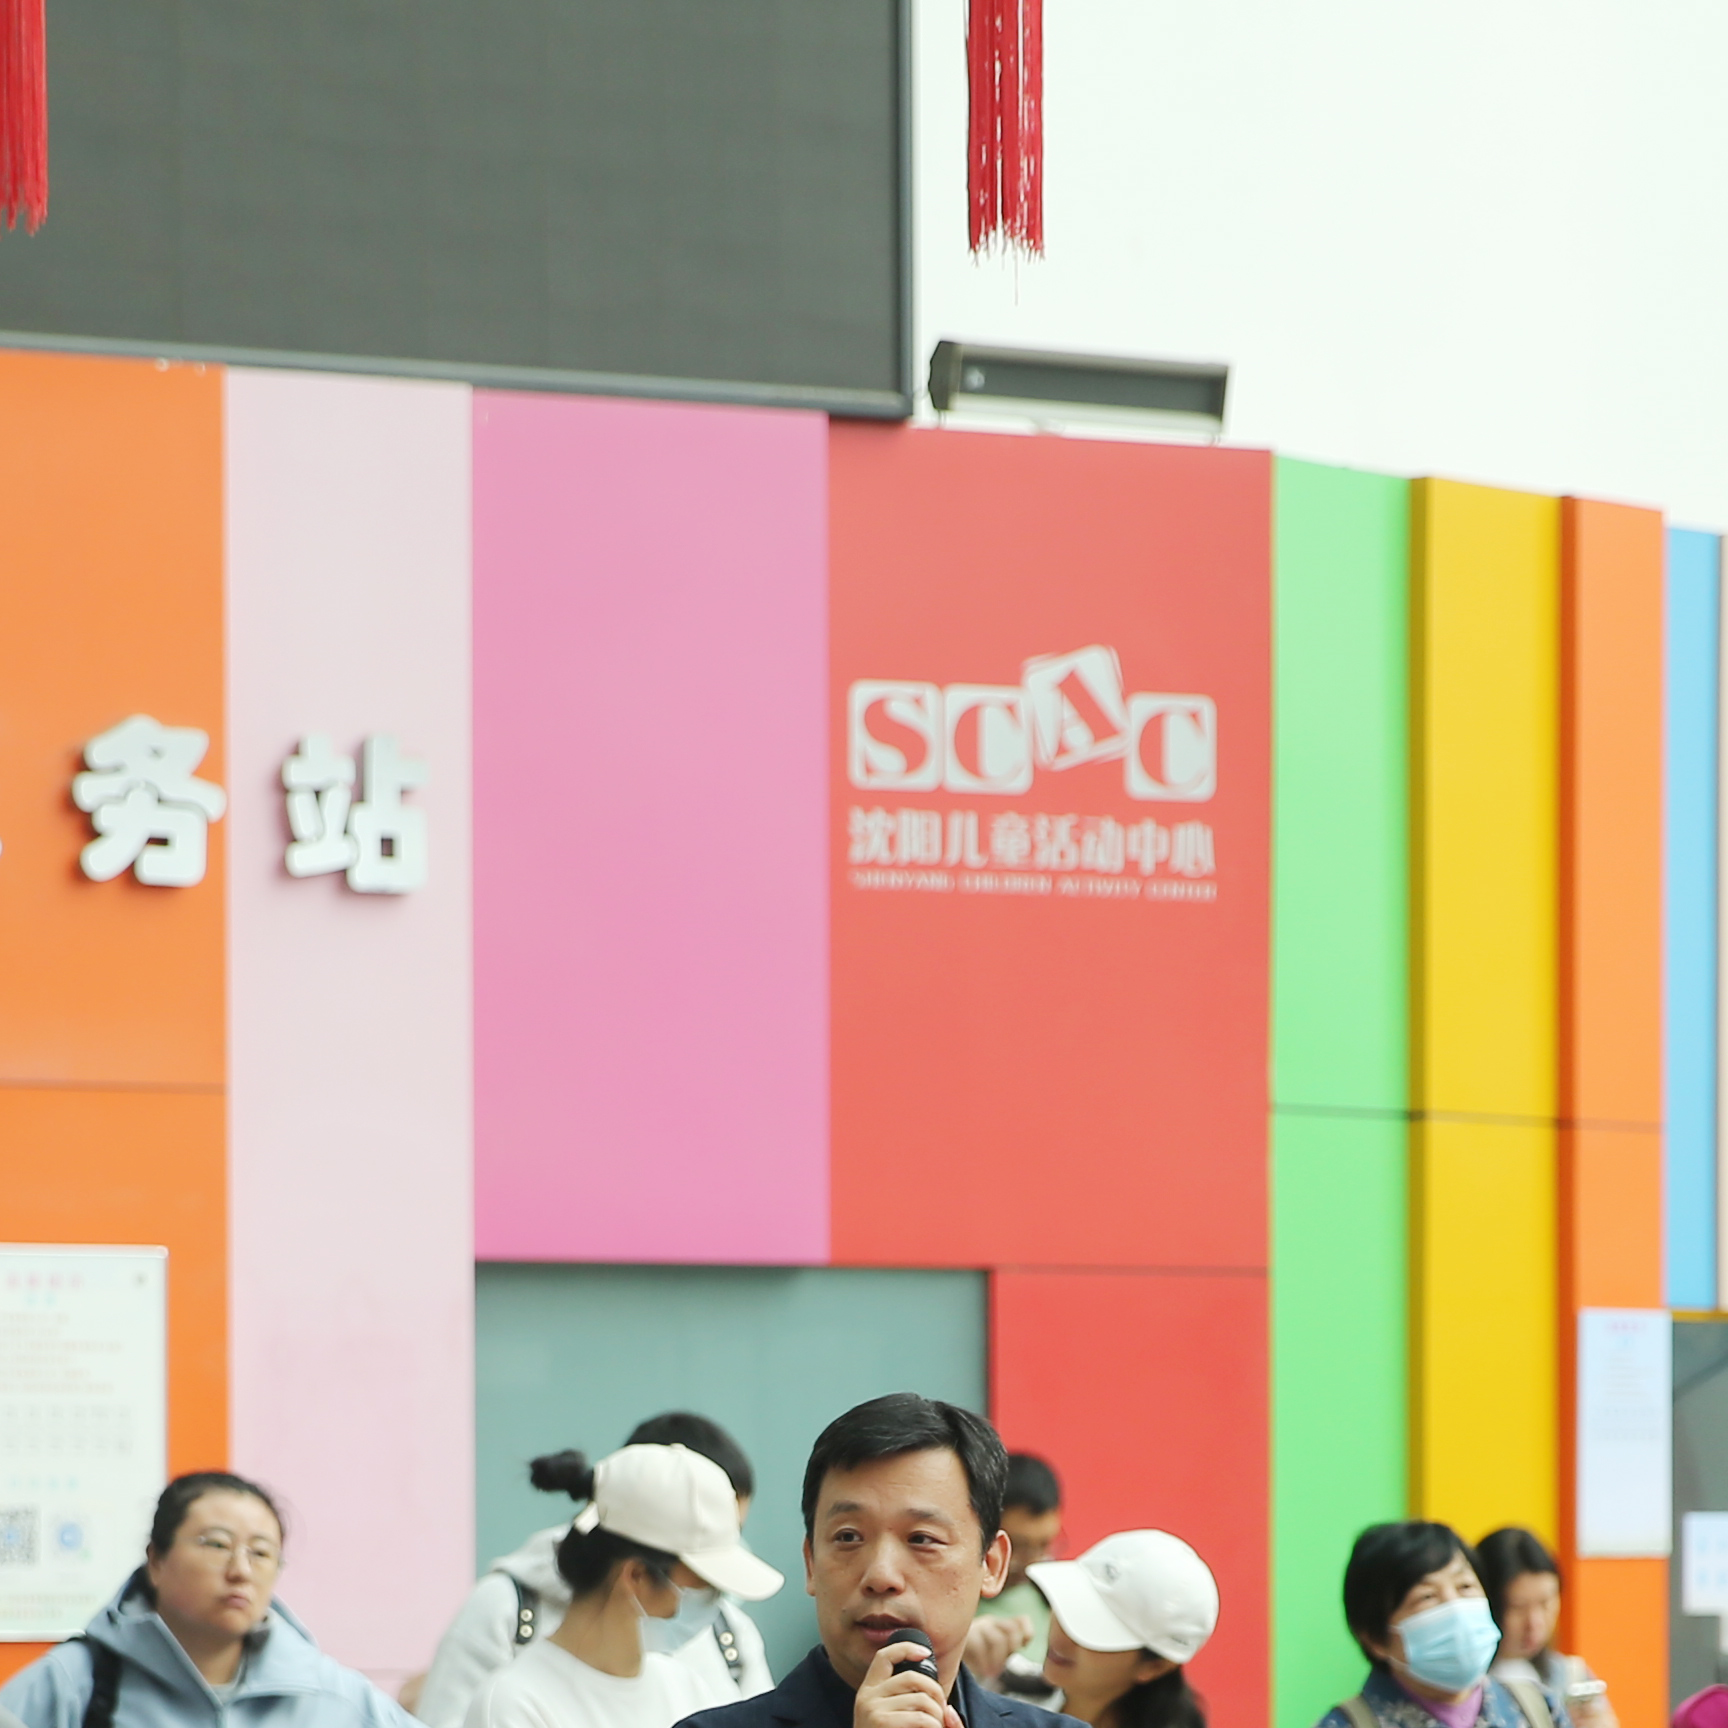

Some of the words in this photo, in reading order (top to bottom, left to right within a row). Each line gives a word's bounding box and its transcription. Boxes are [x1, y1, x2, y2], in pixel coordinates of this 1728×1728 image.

[852, 648, 1215, 801] SCAC
[849, 806, 1216, 877] 沈阳儿童活动中心
